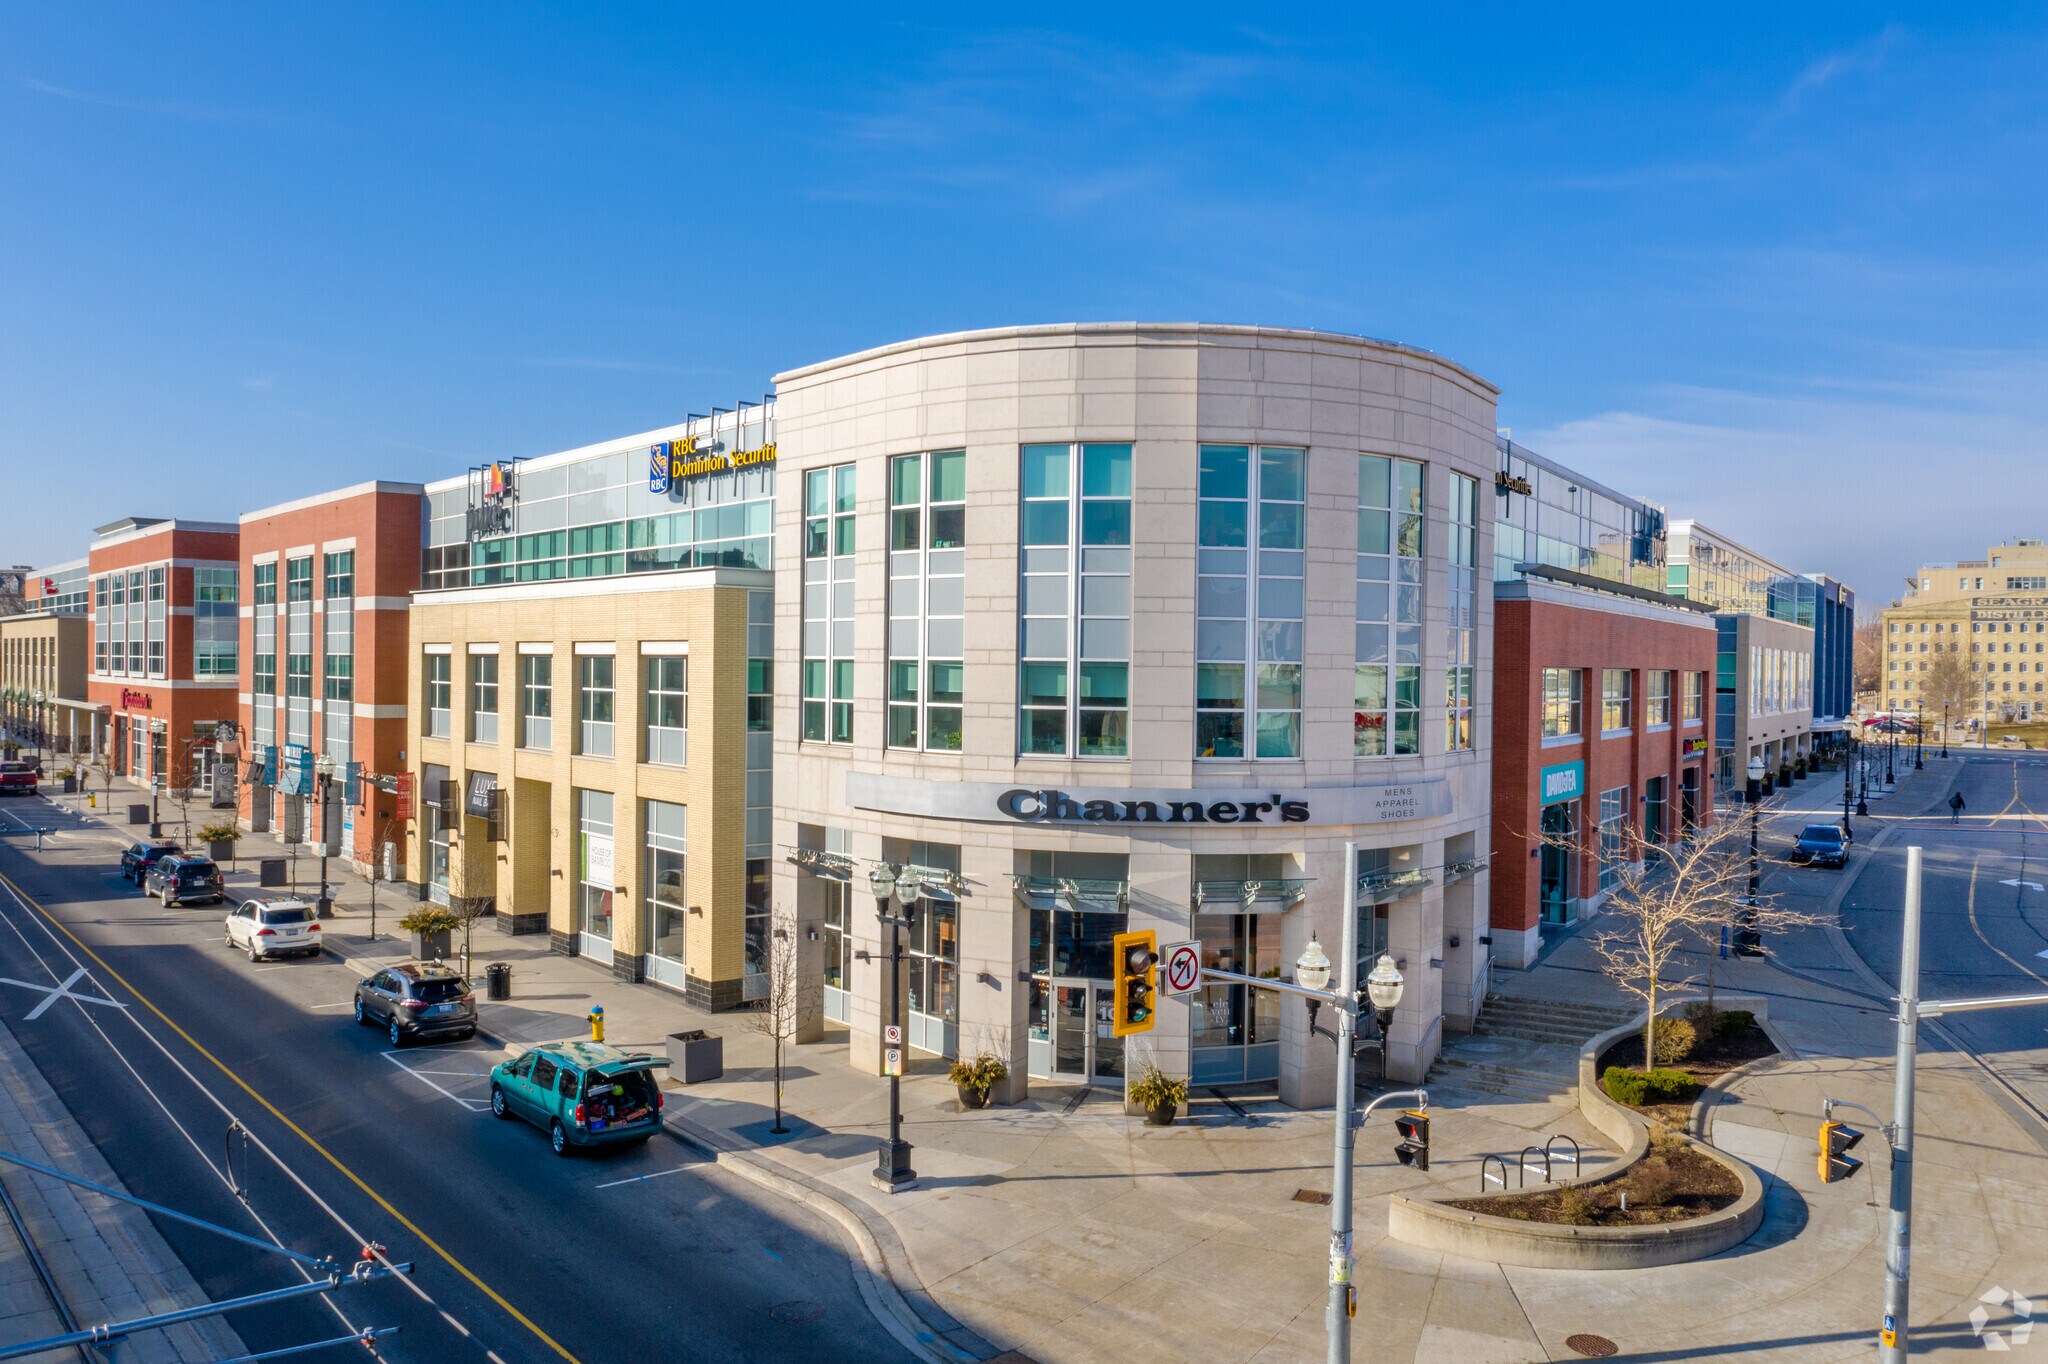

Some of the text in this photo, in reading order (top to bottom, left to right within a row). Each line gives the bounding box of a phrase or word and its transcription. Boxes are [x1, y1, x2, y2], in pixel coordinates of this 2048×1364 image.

[673, 435, 697, 457] RBC
[672, 441, 777, 478] Dominion Securiti
[650, 477, 666, 491] RBC
[1504, 471, 1532, 496] Securities
[1976, 598, 2048, 606] SEAGR
[1976, 611, 2048, 619] DISTILL
[1384, 788, 1412, 796] MENS
[472, 796, 482, 807] NAIL
[996, 789, 1310, 823] Channer's
[1375, 798, 1419, 808] APPAREL
[1381, 809, 1415, 819] SHOES
[591, 846, 612, 858] HOUSE OF
[591, 855, 612, 868] BAMBOO
